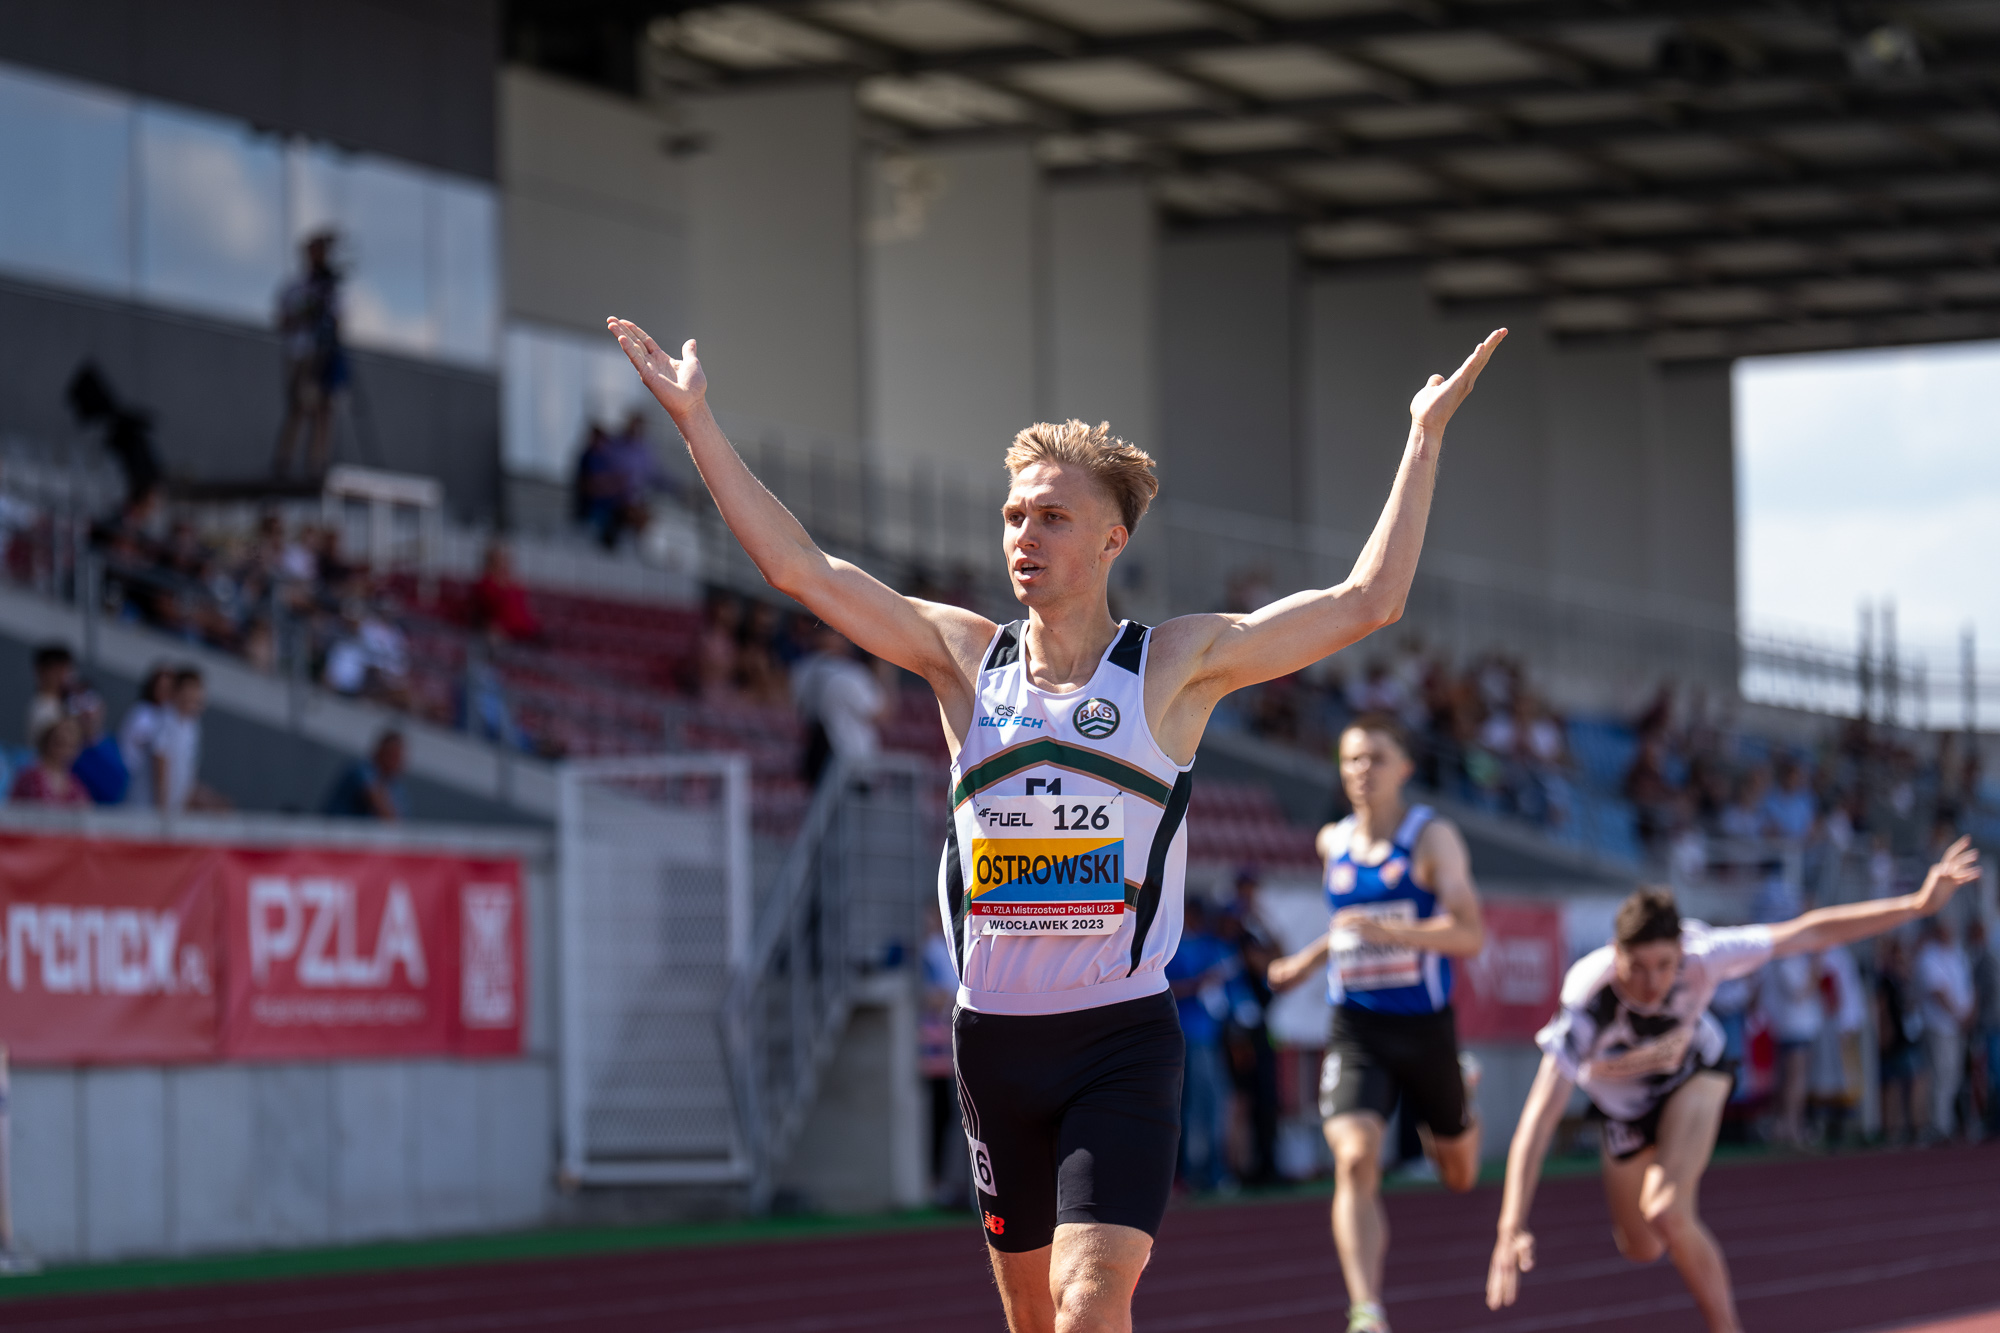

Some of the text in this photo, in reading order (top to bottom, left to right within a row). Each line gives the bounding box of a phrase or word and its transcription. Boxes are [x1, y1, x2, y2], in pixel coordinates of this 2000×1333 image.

[1080, 703, 1112, 721] RKS
[978, 716, 1043, 729] IGLOECH
[989, 813, 1033, 827] FUEL
[1052, 804, 1110, 830] 126
[976, 854, 1119, 885] OSTROWSKI
[981, 904, 1115, 914] 40. PZLA Mistrzostwa Polski U23
[247, 876, 428, 989] PZLA
[989, 919, 1104, 930] WŁOCŁAWEK 2023
